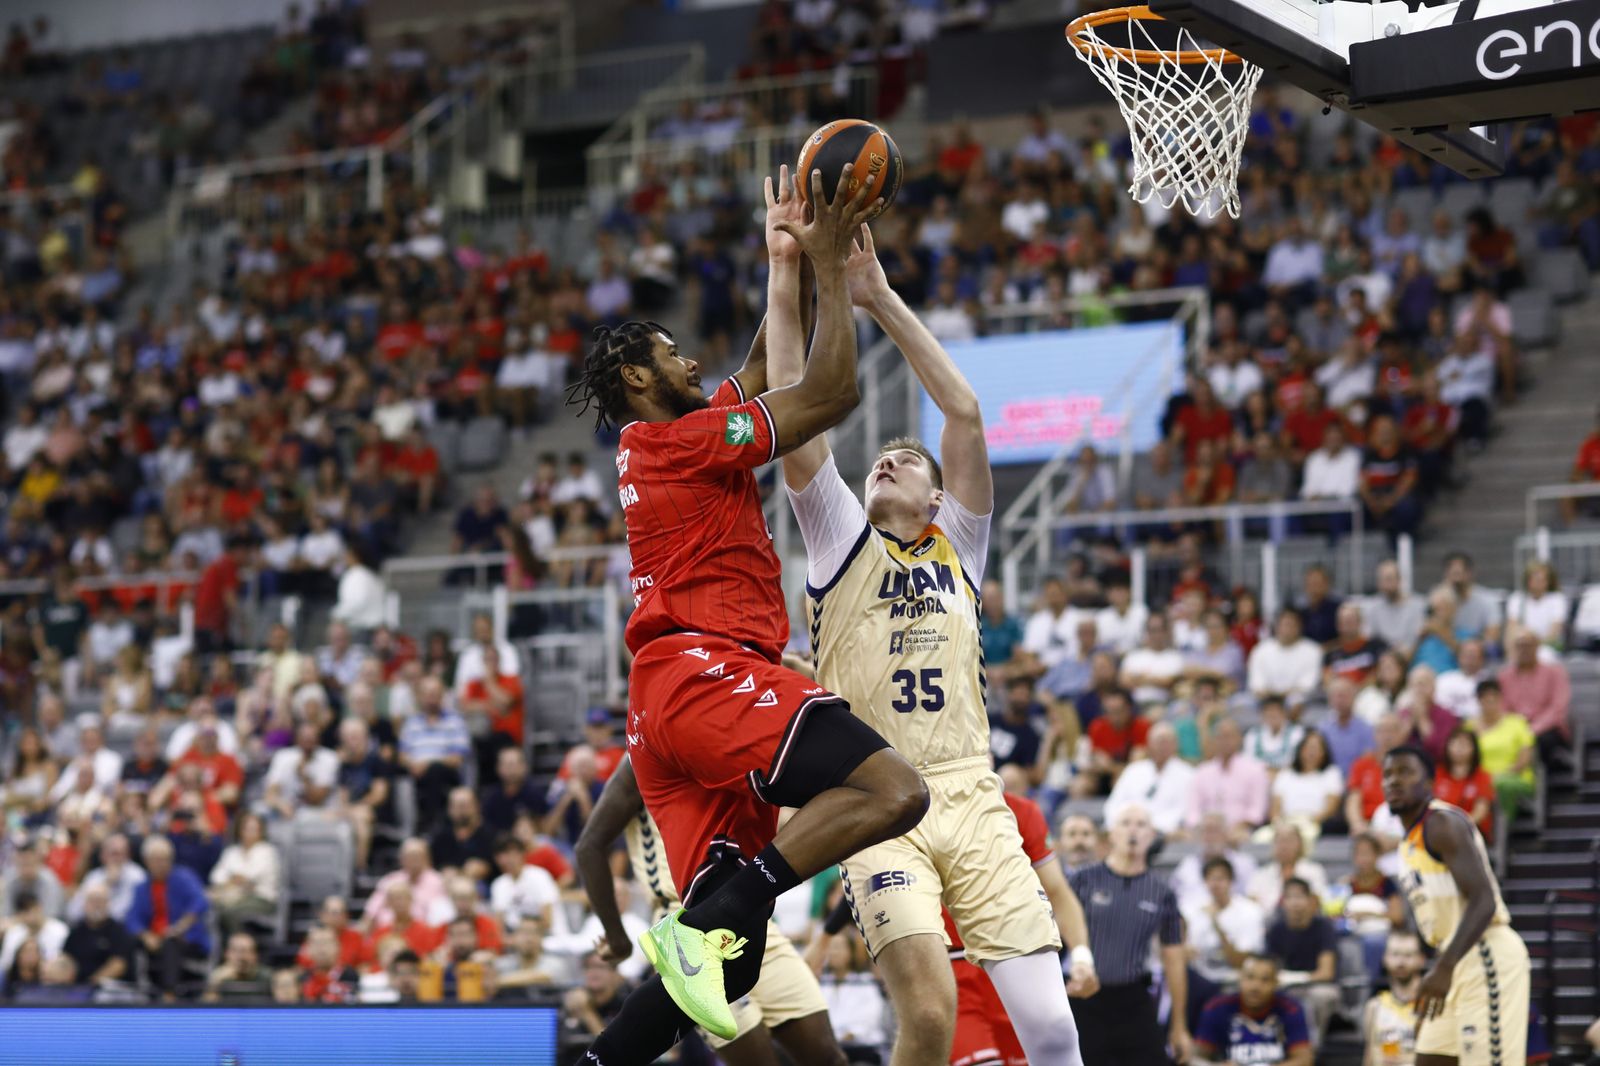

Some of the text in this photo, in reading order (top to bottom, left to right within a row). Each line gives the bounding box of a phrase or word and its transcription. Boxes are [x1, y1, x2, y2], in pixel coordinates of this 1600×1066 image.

[878, 560, 956, 602] UCAM
[891, 668, 945, 713] 35
[873, 871, 917, 892] ESP
